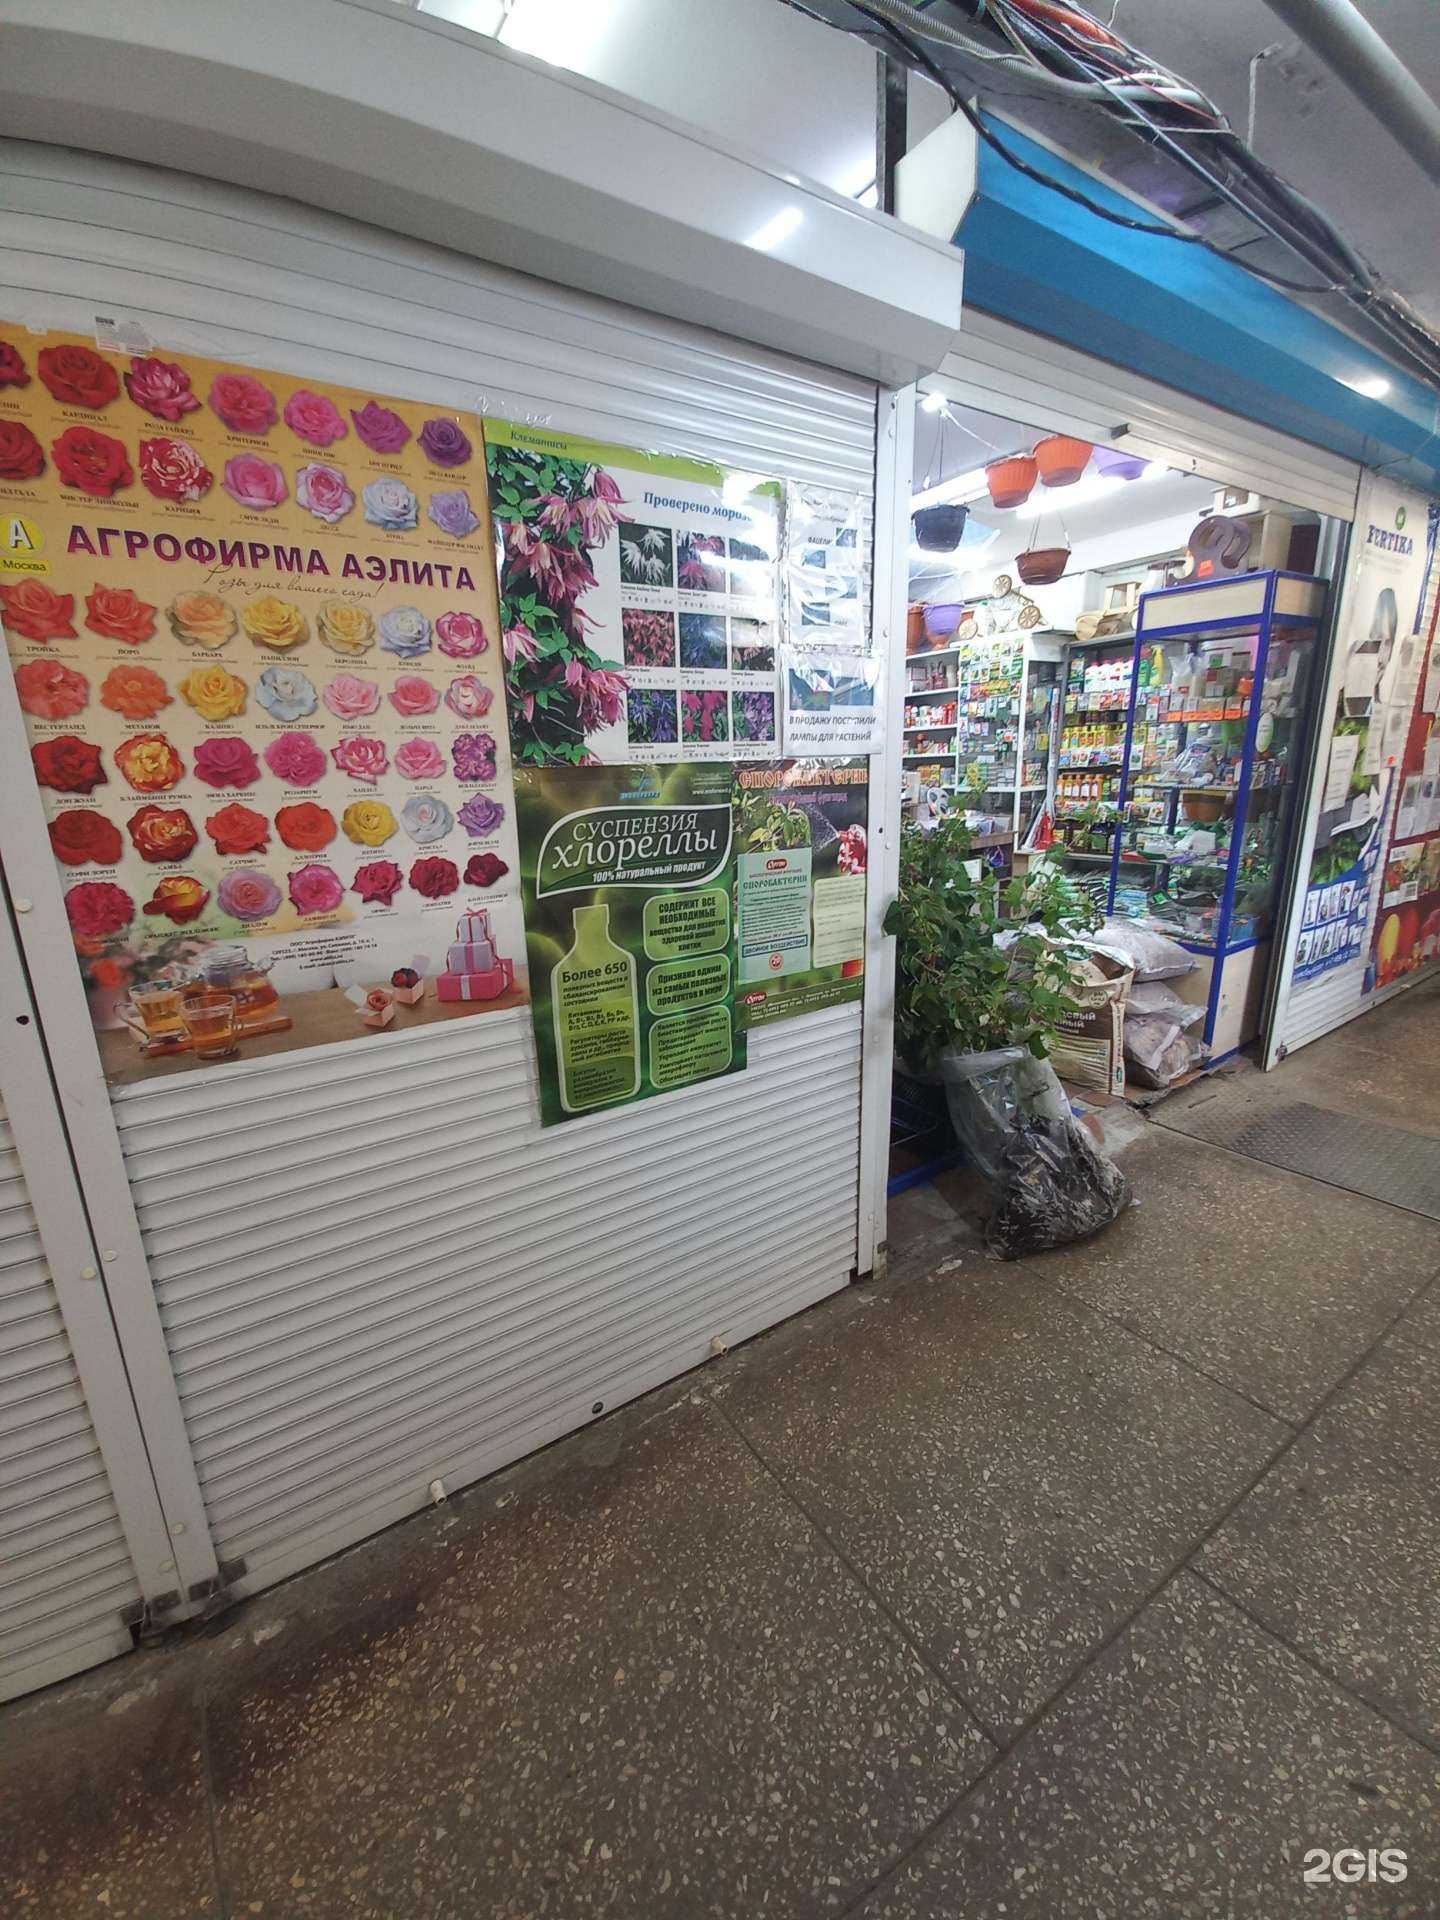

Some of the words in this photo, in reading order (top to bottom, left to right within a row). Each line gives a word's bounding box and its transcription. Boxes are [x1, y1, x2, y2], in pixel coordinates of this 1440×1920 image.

[643, 491, 710, 514] Проверено
[1366, 524, 1414, 556] FERTIKA
[2, 559, 48, 573] Москва
[66, 524, 331, 577] АГРОФИРМА
[341, 552, 477, 592] АЭЛИТА
[832, 716, 876, 725] ПОСТПИЛИ
[572, 812, 698, 842] СУСПЕНЗИЯ
[592, 869, 615, 883] 100%
[615, 863, 673, 881] натуральный
[672, 860, 707, 876] продукт
[658, 899, 700, 914] СОДЕРЖИТ
[701, 896, 717, 907] ВСЕ
[658, 908, 717, 925] НЕОБХОДИМЫЕ
[561, 967, 602, 984] Более
[604, 961, 628, 976] 650
